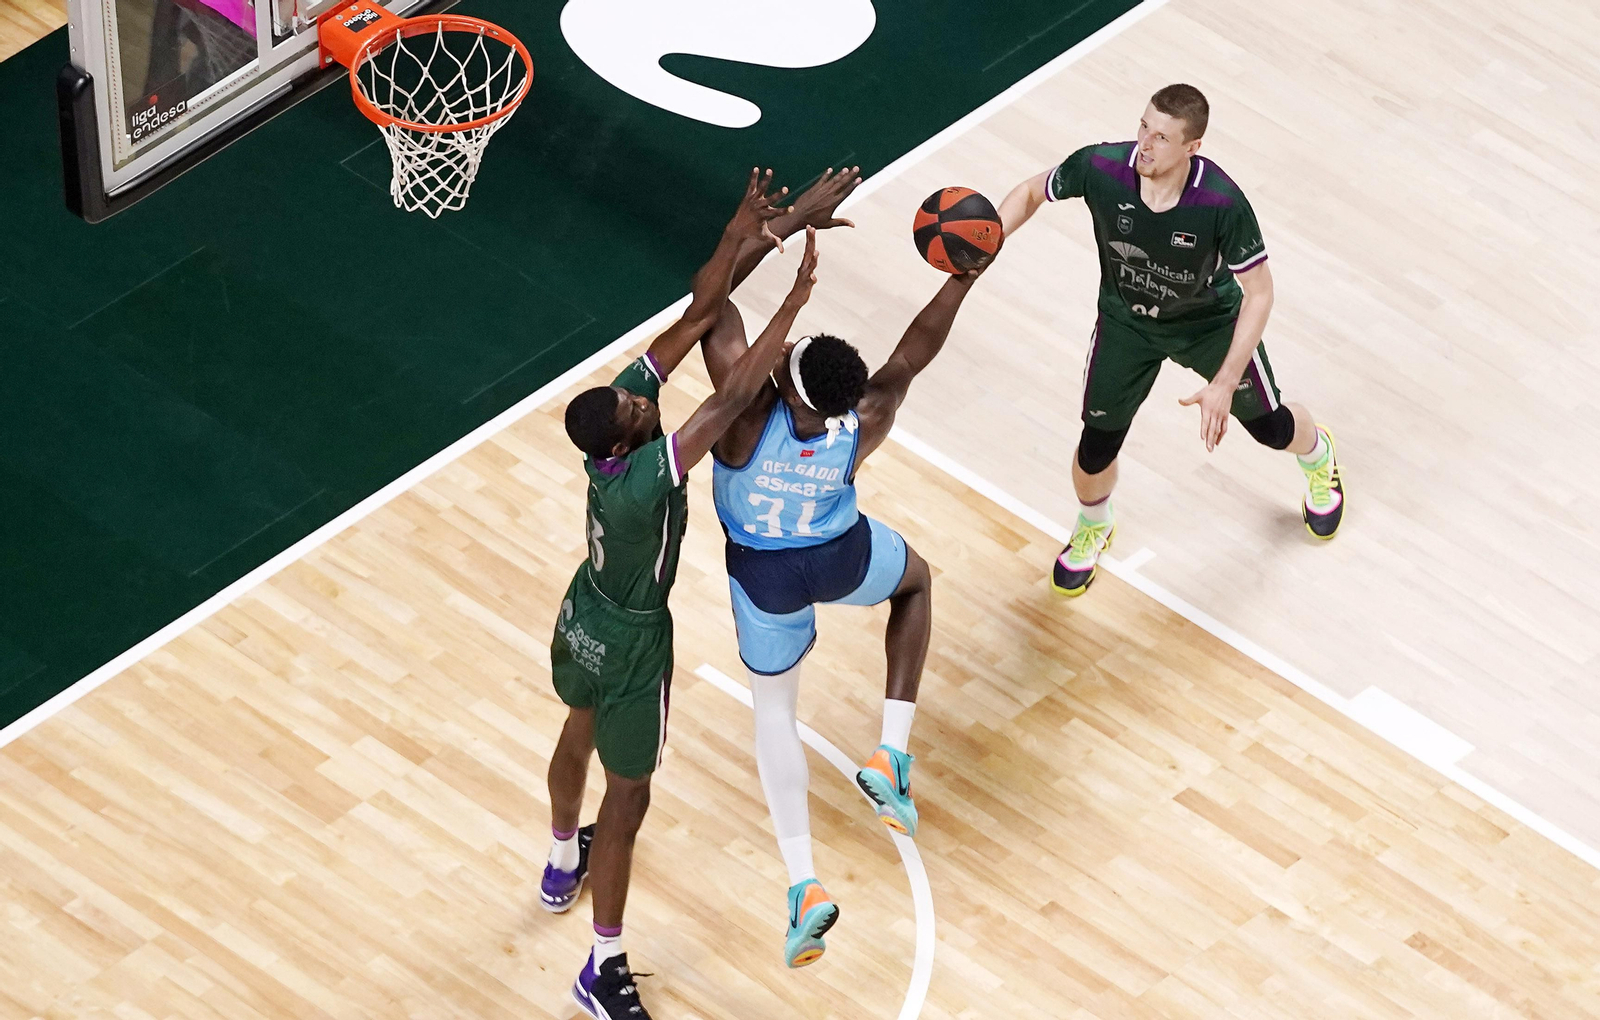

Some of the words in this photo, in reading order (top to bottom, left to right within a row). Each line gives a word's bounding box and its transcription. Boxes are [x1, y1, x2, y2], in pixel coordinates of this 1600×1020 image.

[132, 105, 156, 127] liga
[133, 100, 186, 139] endesa
[1120, 263, 1180, 301] Málaga
[1146, 260, 1195, 282] Unicaja
[762, 459, 840, 481] DELGADO
[743, 492, 823, 538] 31
